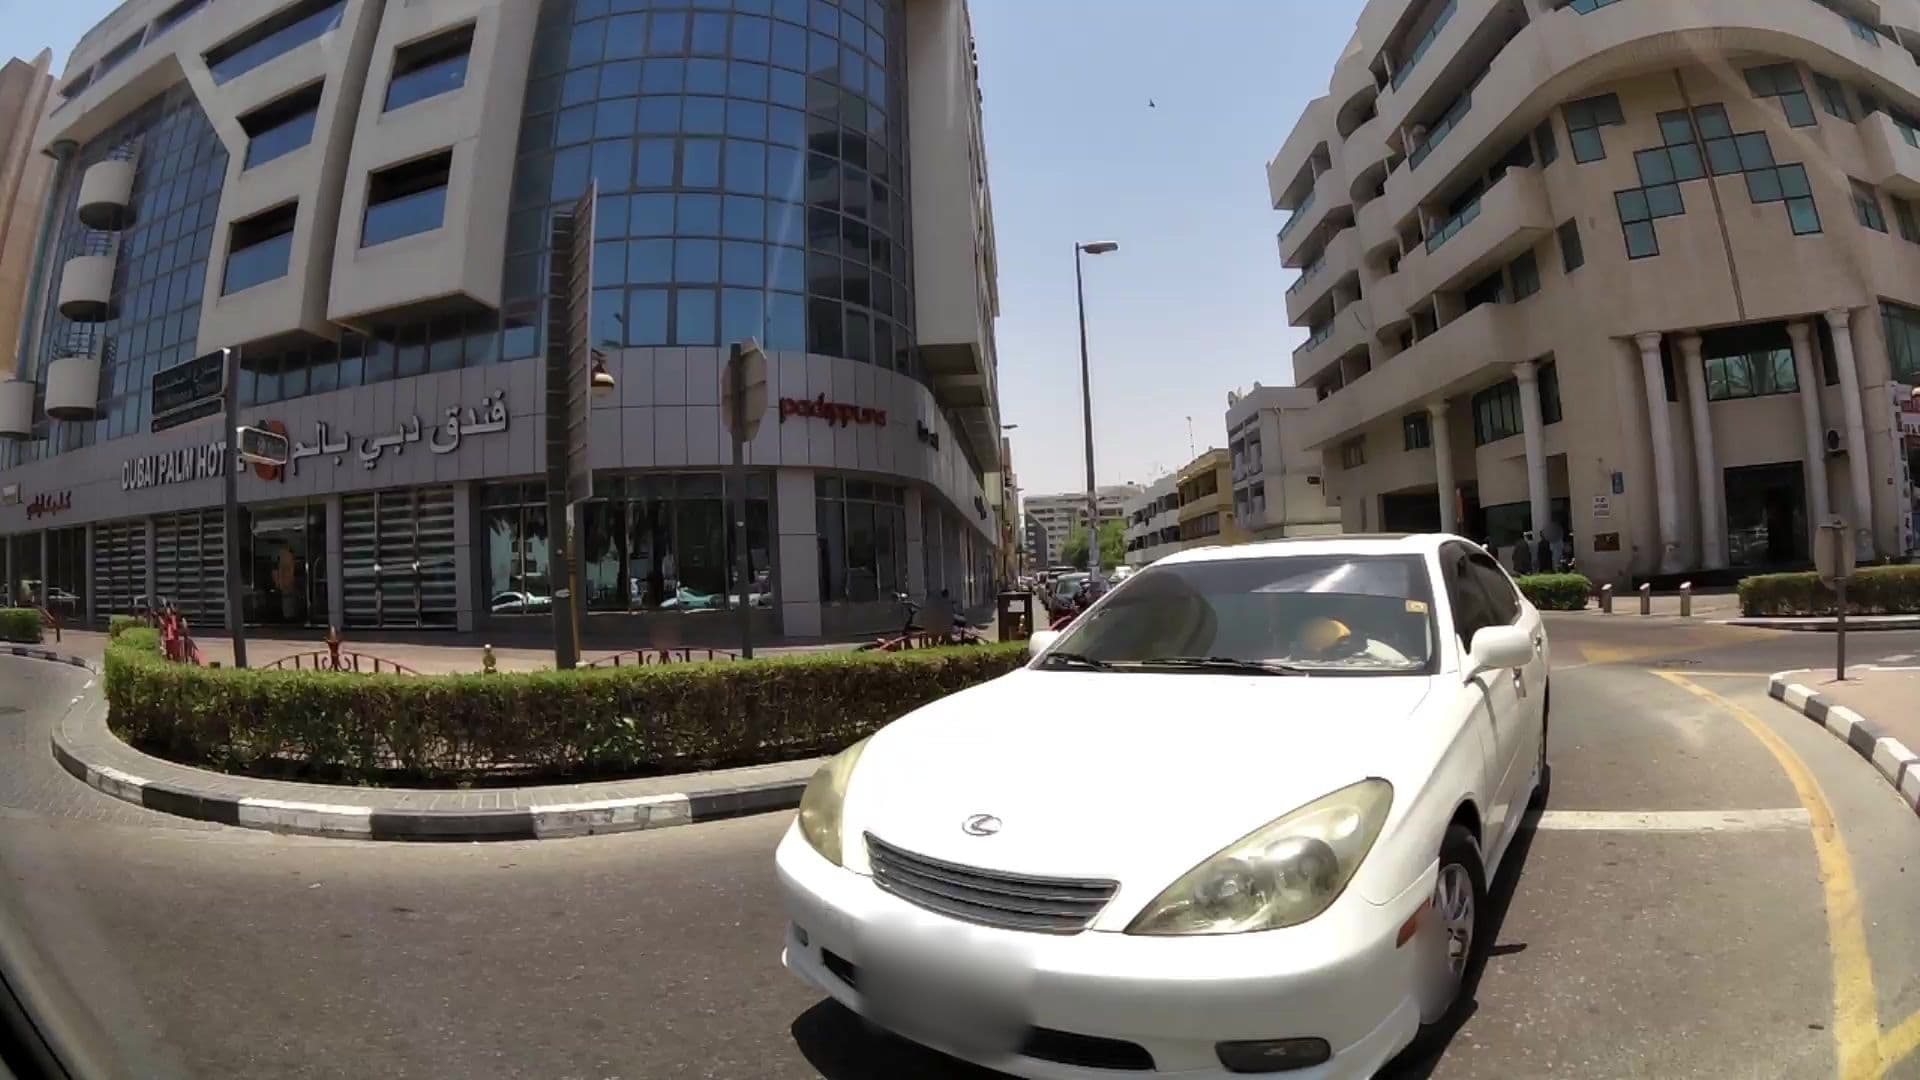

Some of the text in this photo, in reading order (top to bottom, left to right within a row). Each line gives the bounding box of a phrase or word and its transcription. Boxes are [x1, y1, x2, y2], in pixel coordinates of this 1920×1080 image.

[291, 388, 510, 476] فندق دبي بالم
[121, 455, 158, 491] DUBAI
[158, 447, 196, 485] PALM
